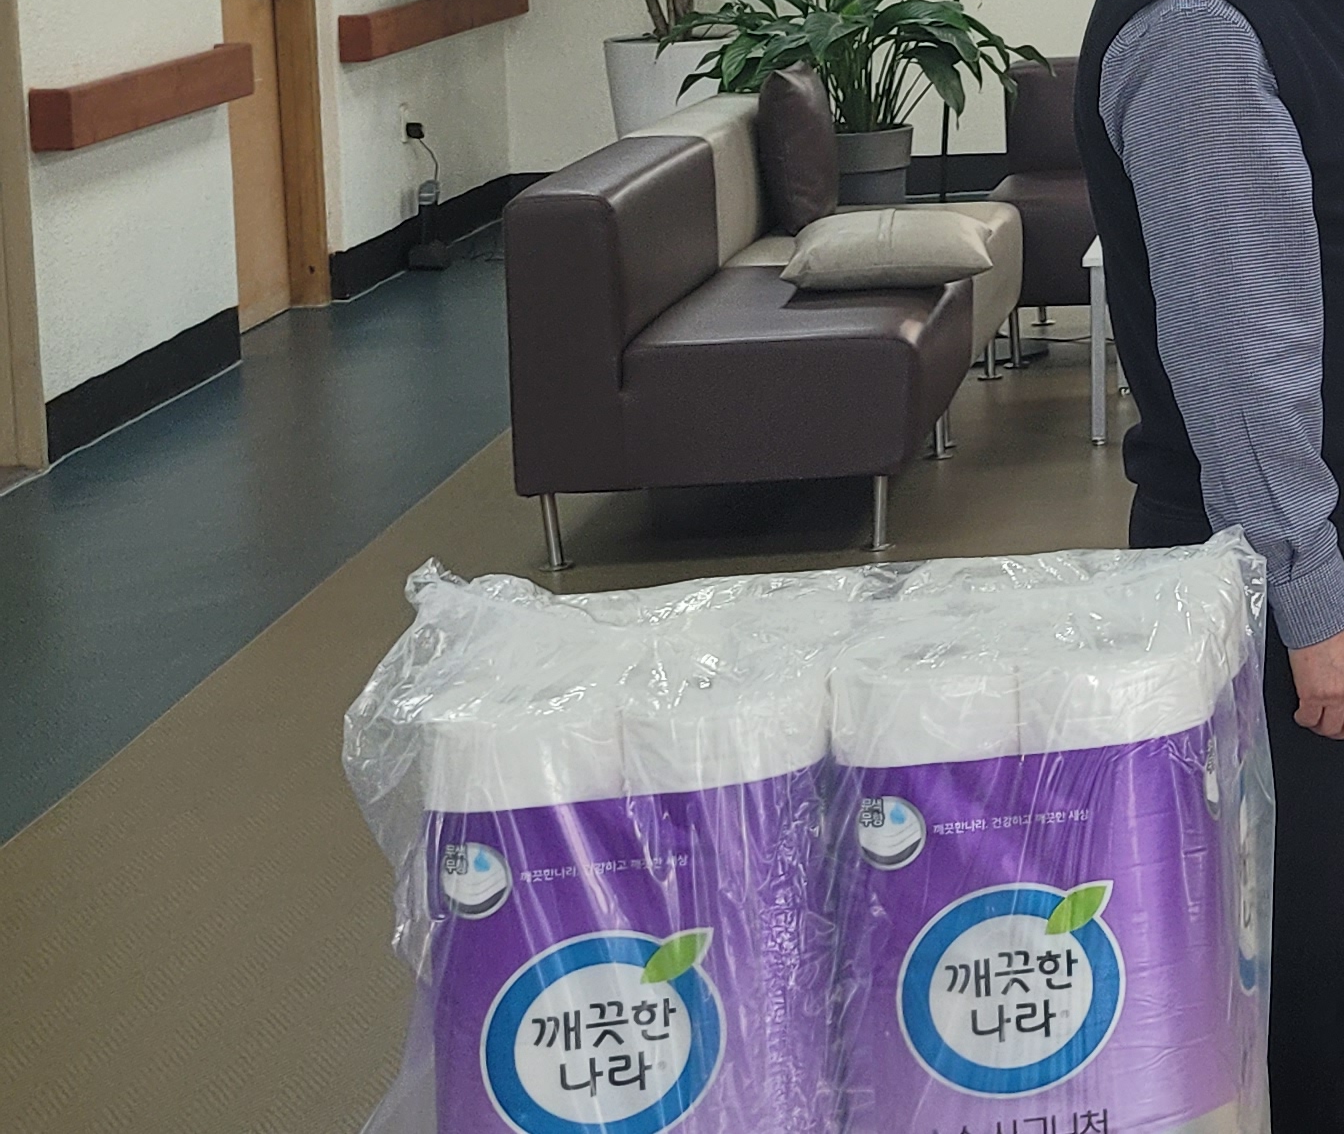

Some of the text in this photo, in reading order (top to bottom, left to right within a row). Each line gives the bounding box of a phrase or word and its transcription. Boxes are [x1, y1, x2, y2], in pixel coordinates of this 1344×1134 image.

[945, 949, 1079, 998] 깨끗한
[532, 998, 677, 1051] 깨끗한
[971, 999, 1057, 1043] 나라
[559, 1051, 653, 1097] 나라
